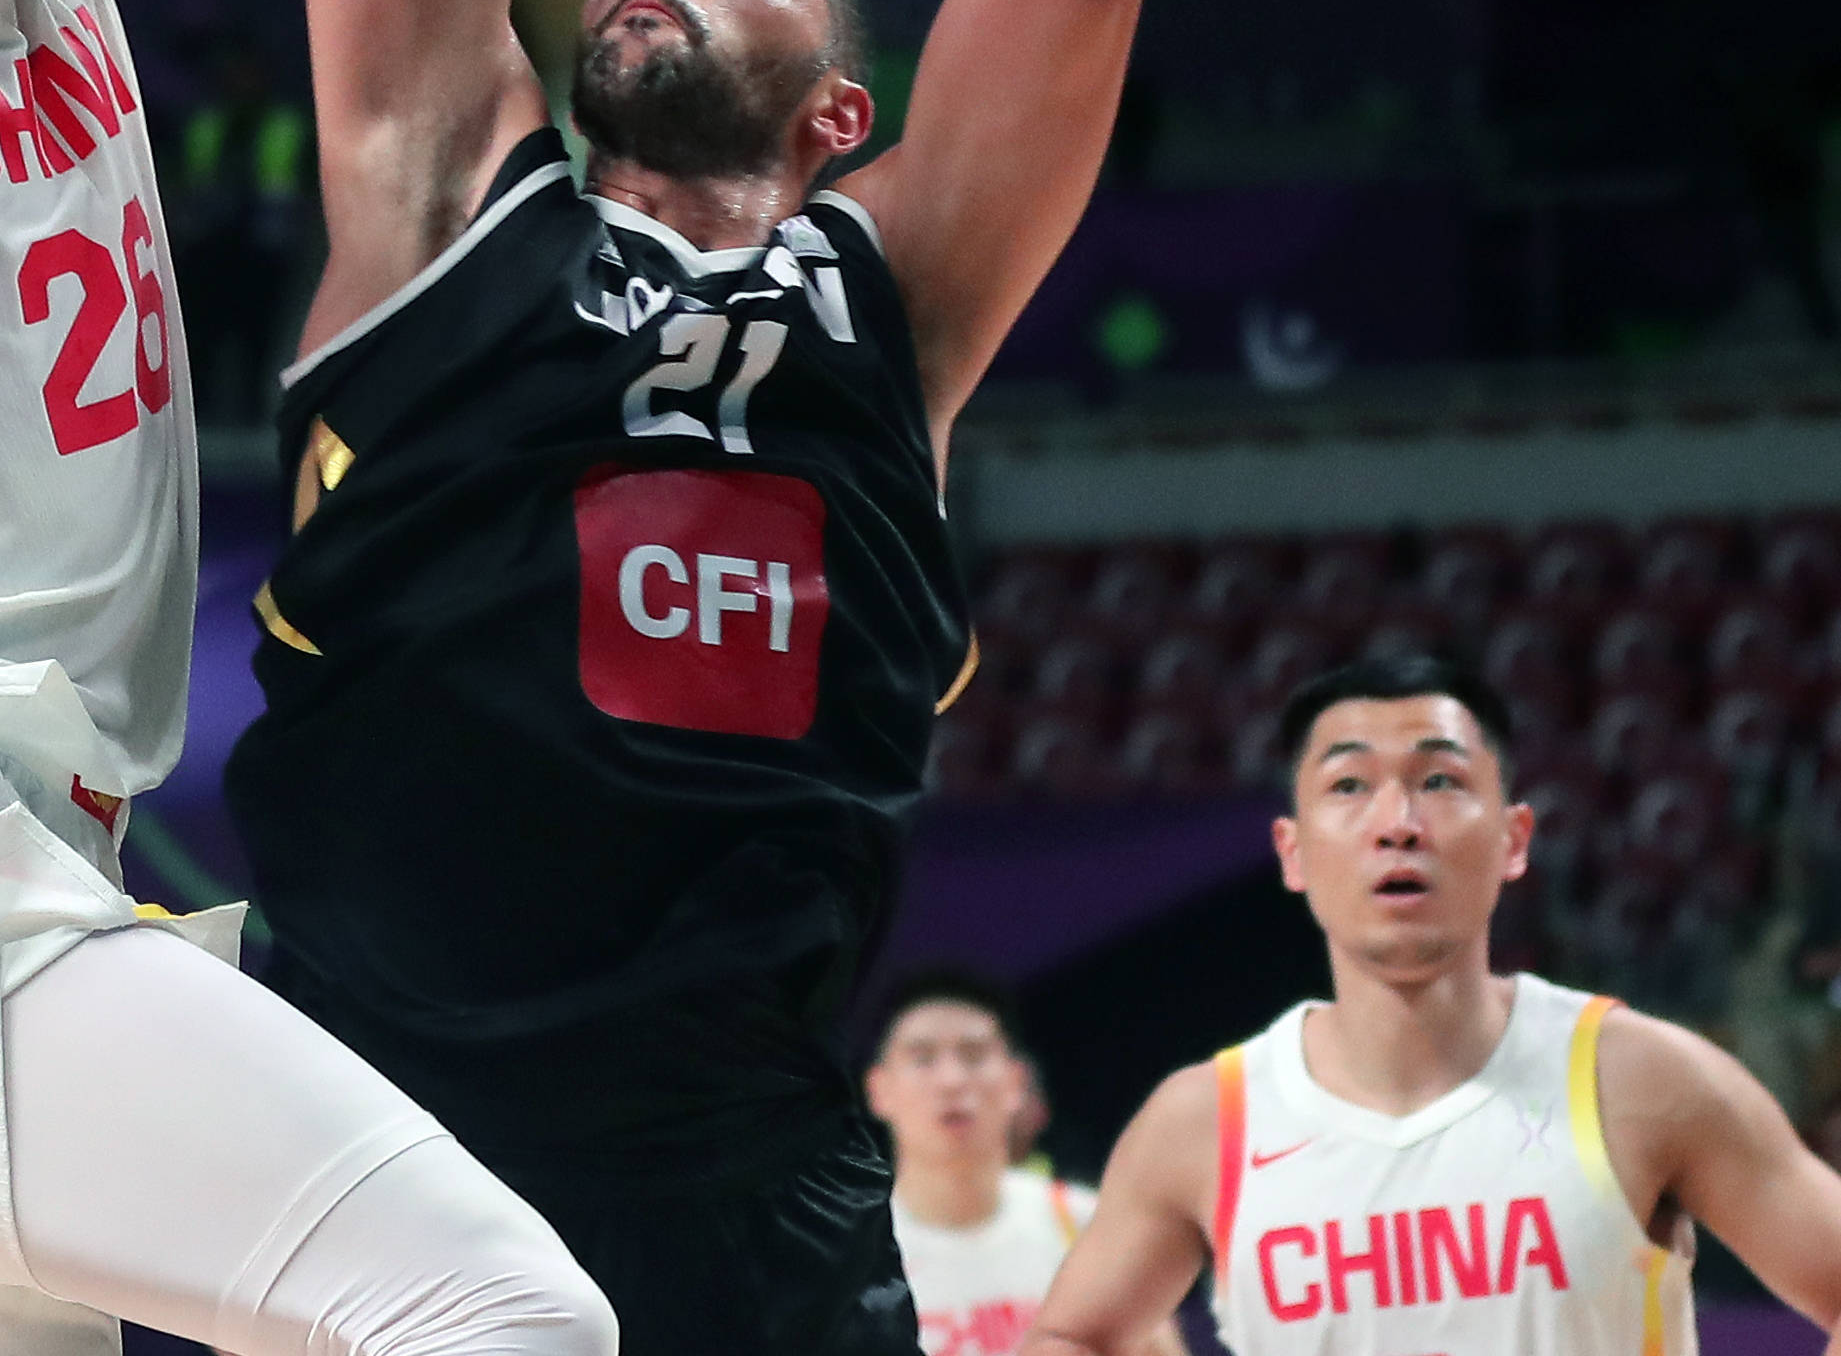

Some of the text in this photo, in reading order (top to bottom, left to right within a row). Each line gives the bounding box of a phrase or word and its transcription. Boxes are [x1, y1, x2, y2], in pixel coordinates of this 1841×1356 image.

[17, 196, 171, 456] 26
[623, 313, 789, 454] 21
[619, 545, 794, 652] CFI
[1257, 1196, 1569, 1323] CHINA
